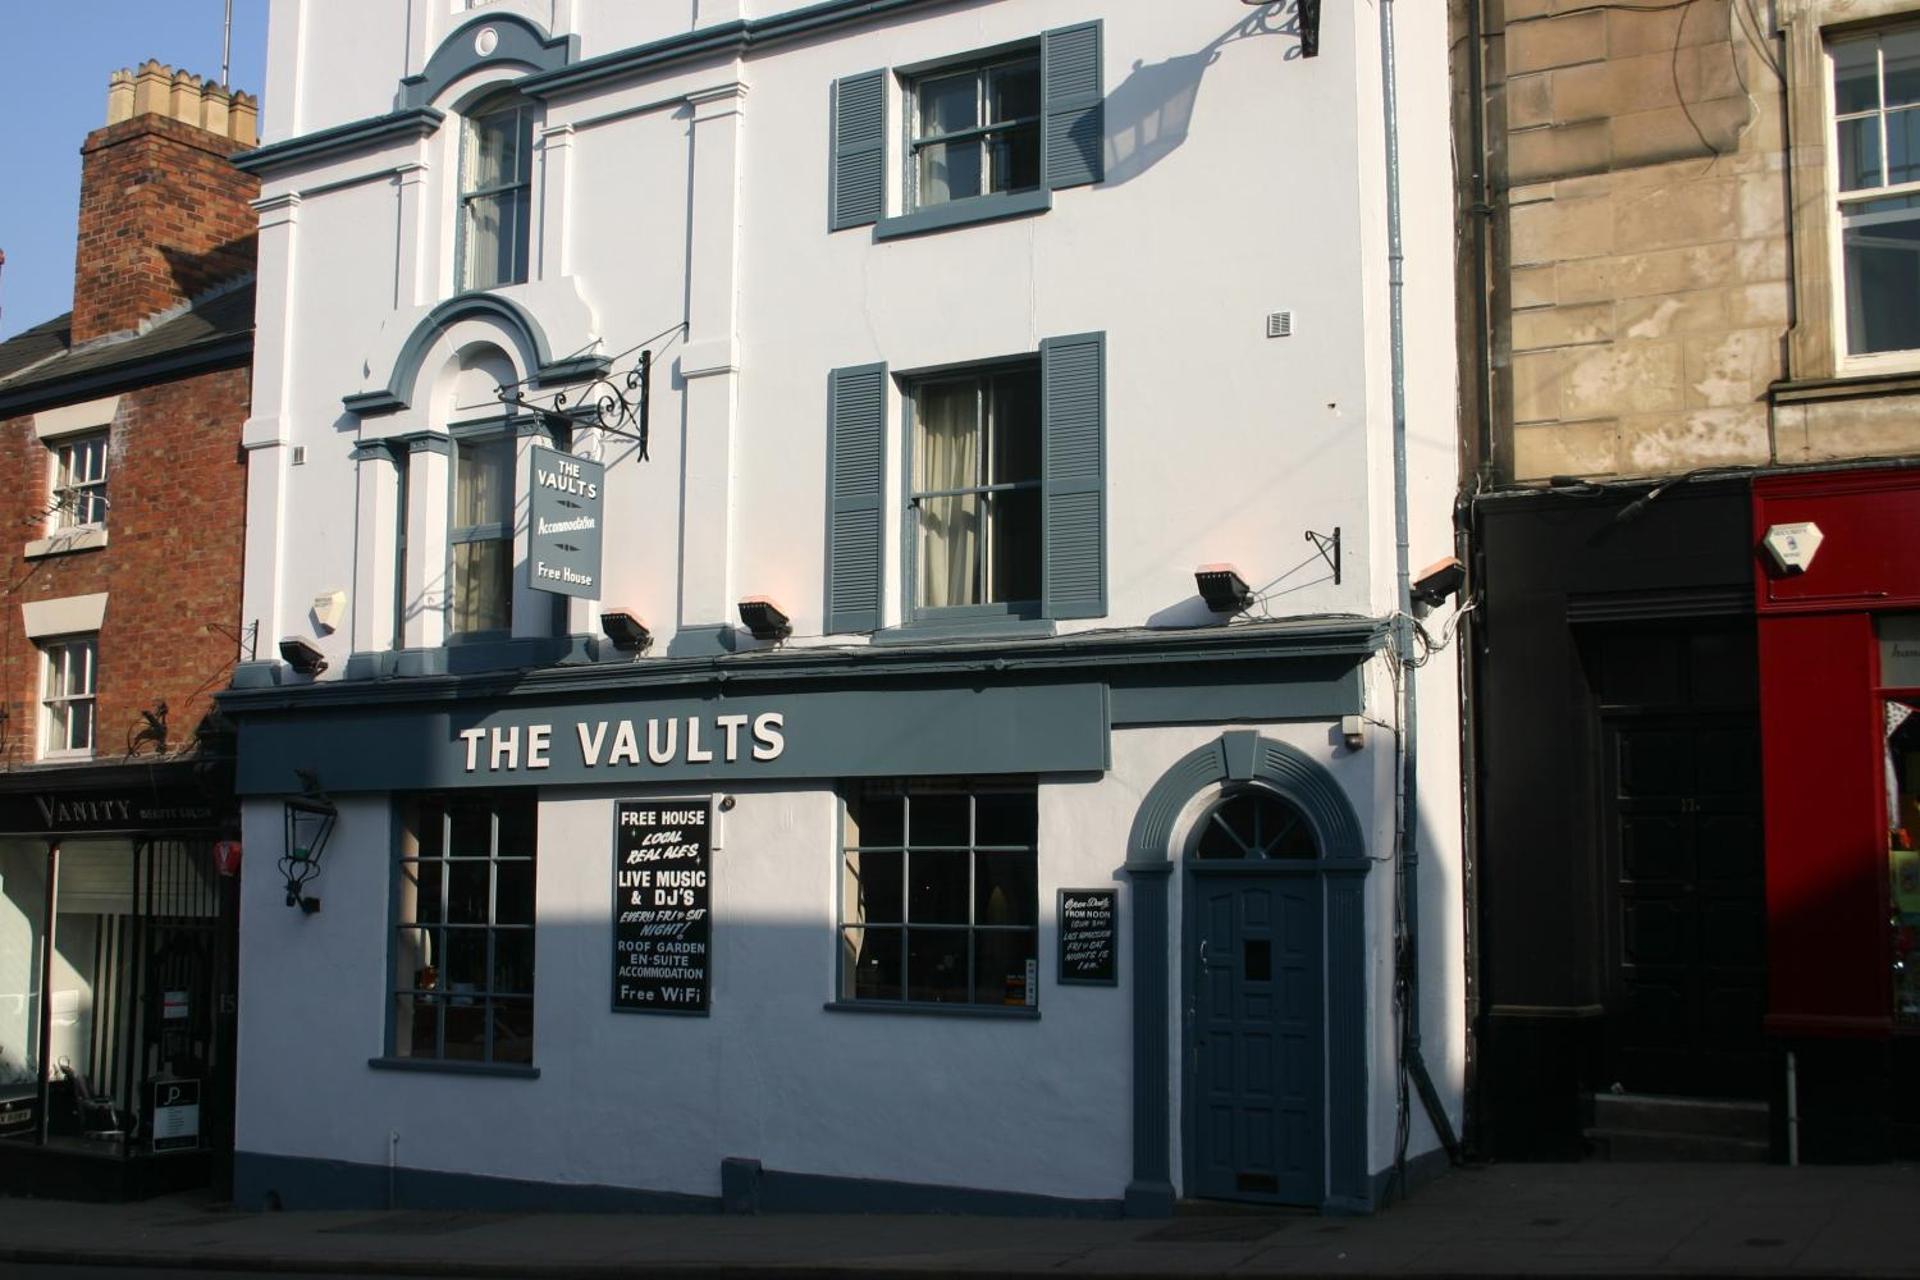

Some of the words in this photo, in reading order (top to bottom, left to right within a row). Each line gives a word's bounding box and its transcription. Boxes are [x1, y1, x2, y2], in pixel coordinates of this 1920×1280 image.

[558, 461, 580, 478] THE
[538, 470, 597, 499] VAULTS
[538, 516, 596, 536] Accommodation
[538, 562, 561, 580] Free
[564, 567, 592, 586] House
[460, 724, 552, 772] THE
[577, 712, 785, 767] VAULTS
[35, 796, 130, 828] VANITY
[621, 811, 656, 825] FREE
[662, 810, 705, 825] HOUSE
[642, 830, 683, 846] LOCAL
[627, 848, 662, 865] REAL
[663, 843, 699, 860] ALES
[619, 871, 651, 888] LIVE
[656, 870, 706, 888] MUSIC
[631, 891, 642, 906] &
[655, 888, 695, 906] DJ'S
[620, 911, 656, 923] EVERY
[657, 910, 678, 921] FRI
[686, 908, 707, 920] SAT
[1086, 910, 1111, 919] NOON
[640, 921, 692, 940] NIGHT!
[618, 940, 651, 951] ROOF
[657, 942, 705, 954] GARDEN
[619, 965, 704, 980] ACCOMMODATION
[620, 985, 655, 1001] Free
[661, 986, 701, 1003] WiFi
